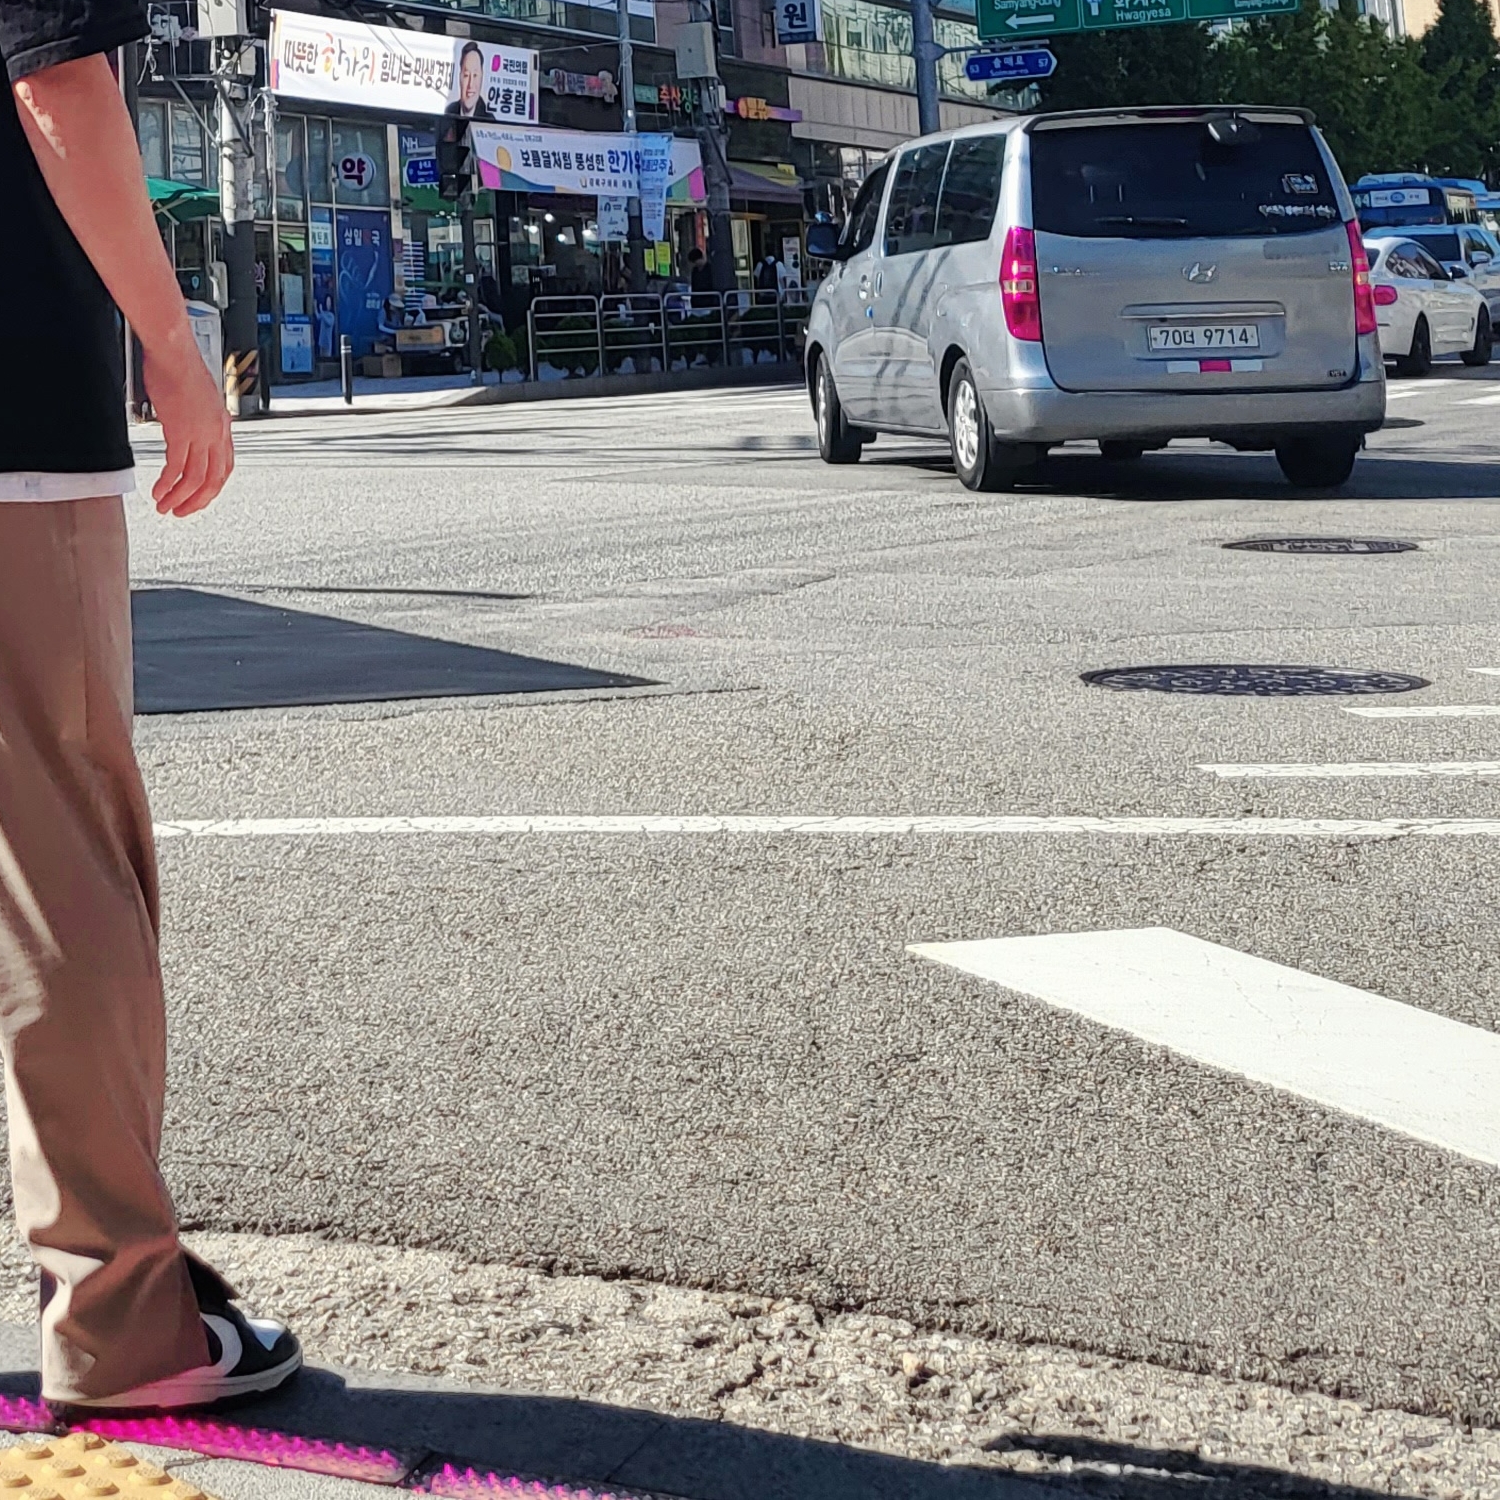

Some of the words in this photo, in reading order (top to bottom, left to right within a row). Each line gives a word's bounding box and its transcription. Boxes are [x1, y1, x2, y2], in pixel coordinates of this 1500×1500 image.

[1116, 5, 1172, 22] Hwagyesa
[283, 38, 319, 76] 따뜻한
[379, 52, 414, 85] 힘나는
[502, 57, 529, 76] 국민의힘
[1037, 57, 1049, 68] 57
[485, 85, 527, 117] 안홍렬
[401, 136, 419, 150] NH
[519, 148, 572, 171] 보름달처럼
[574, 150, 606, 173] 풍성한
[342, 156, 367, 187] 약
[1159, 328, 1195, 348] 70더
[1203, 327, 1250, 347] 9714
